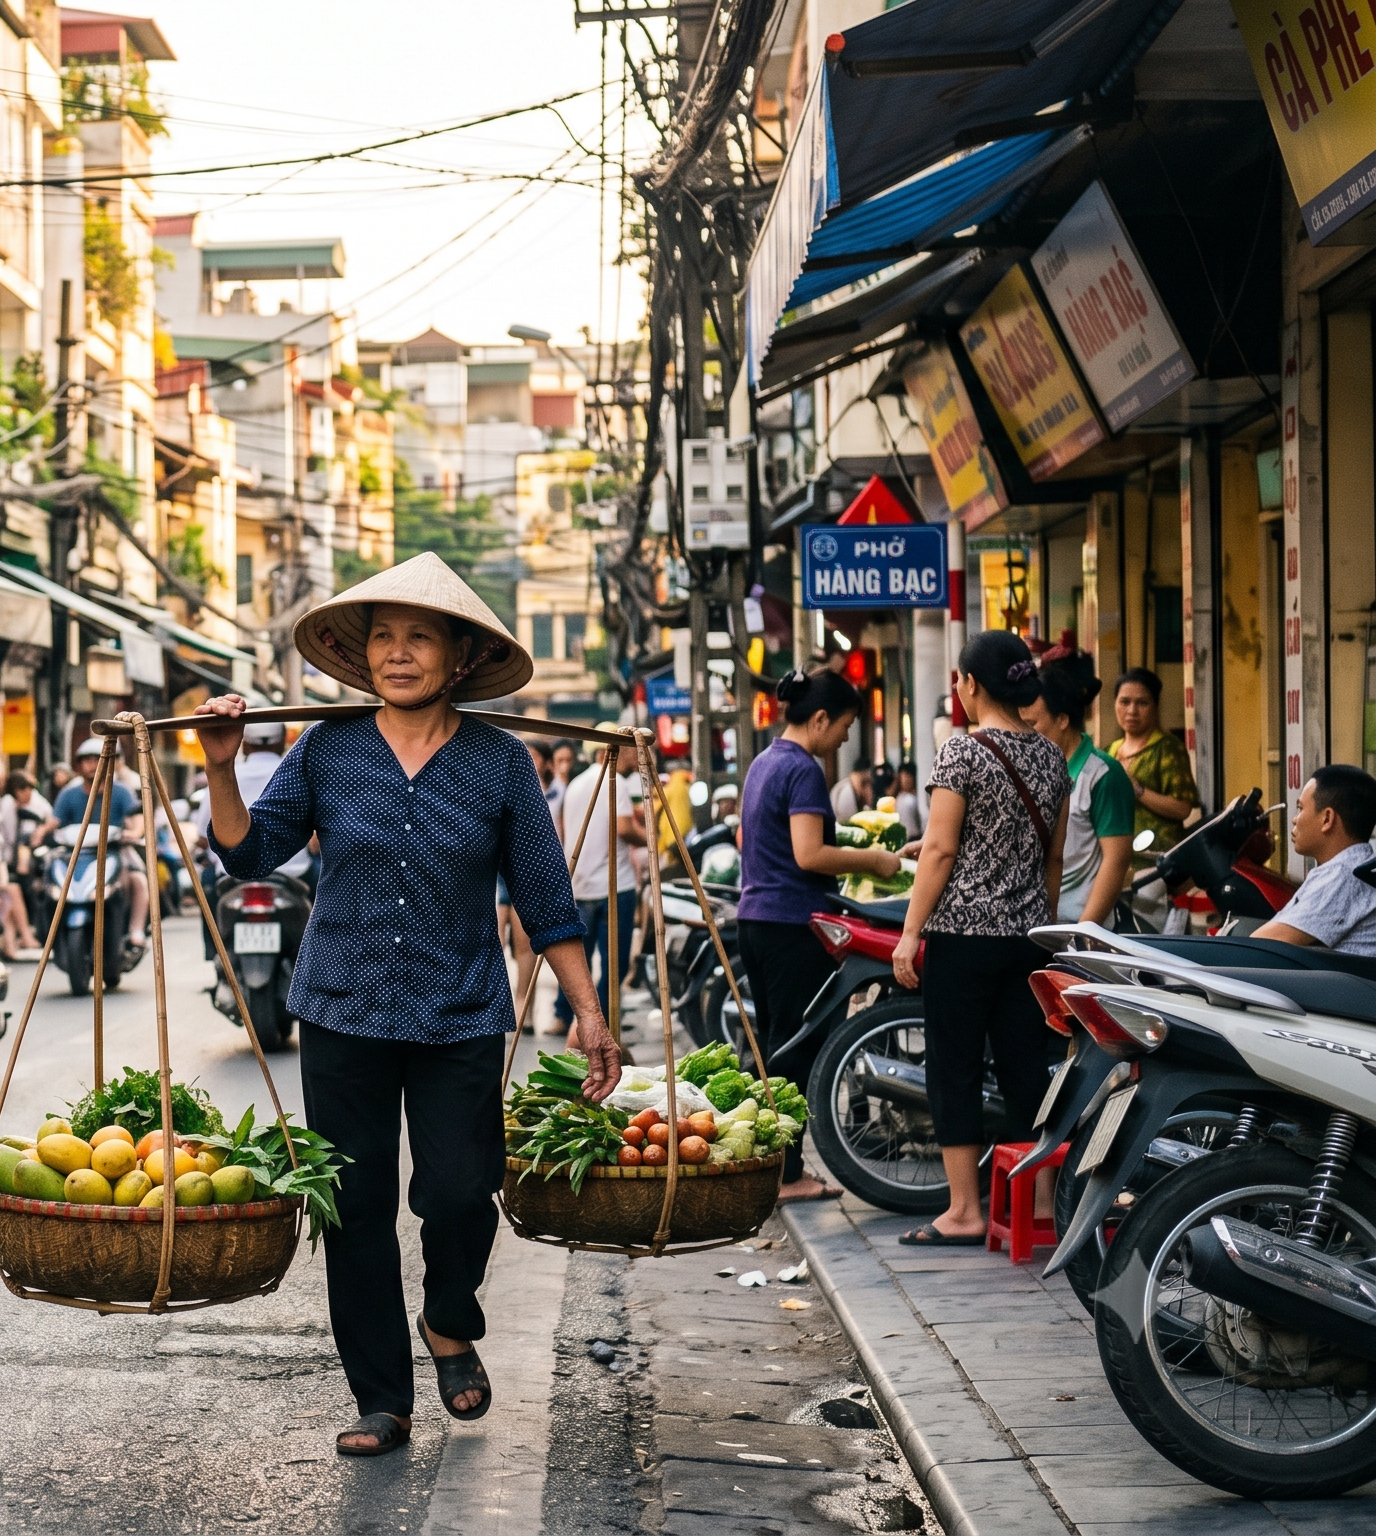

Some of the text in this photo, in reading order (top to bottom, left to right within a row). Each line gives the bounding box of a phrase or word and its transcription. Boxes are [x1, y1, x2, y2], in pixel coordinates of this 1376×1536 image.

[1265, 11, 1320, 133] CÀ
[853, 535, 906, 558] PHỞ
[814, 562, 937, 601] HÀNG BẠC
